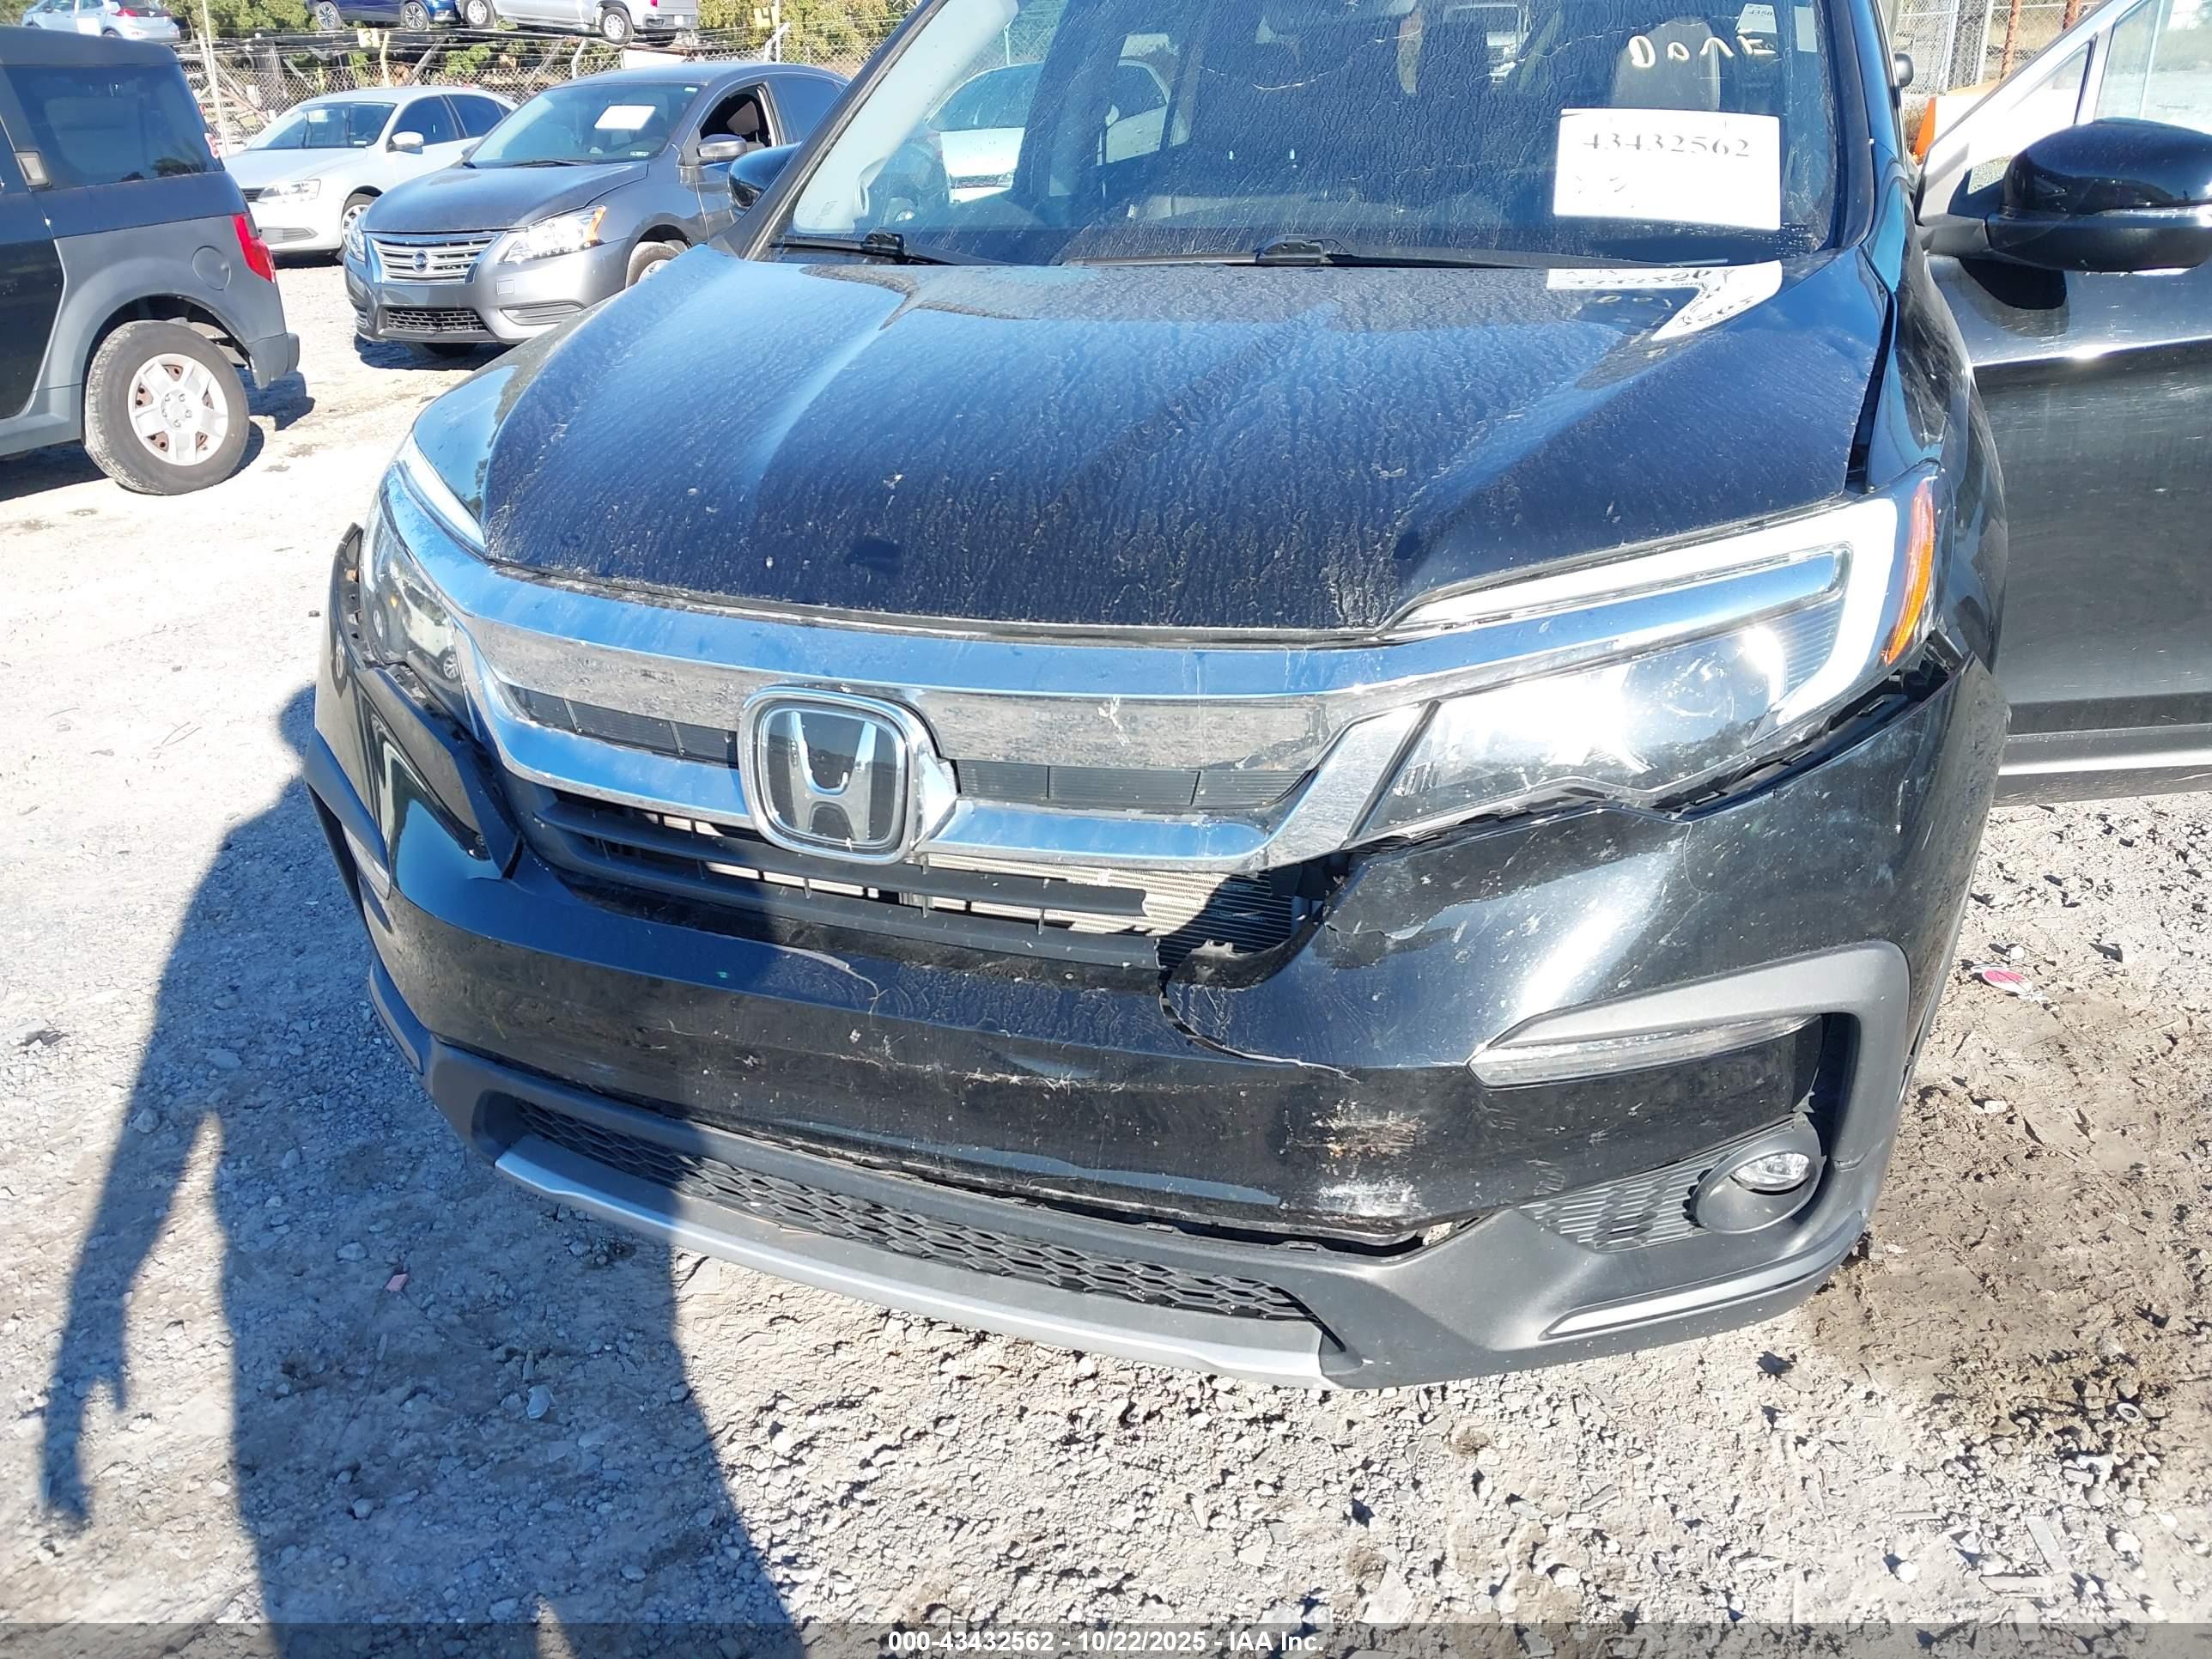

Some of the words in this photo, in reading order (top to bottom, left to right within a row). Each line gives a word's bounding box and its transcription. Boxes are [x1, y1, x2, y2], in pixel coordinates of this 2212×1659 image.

[759, 7, 774, 27] 4
[362, 27, 374, 48] 3
[1583, 132, 1749, 157] 43432562
